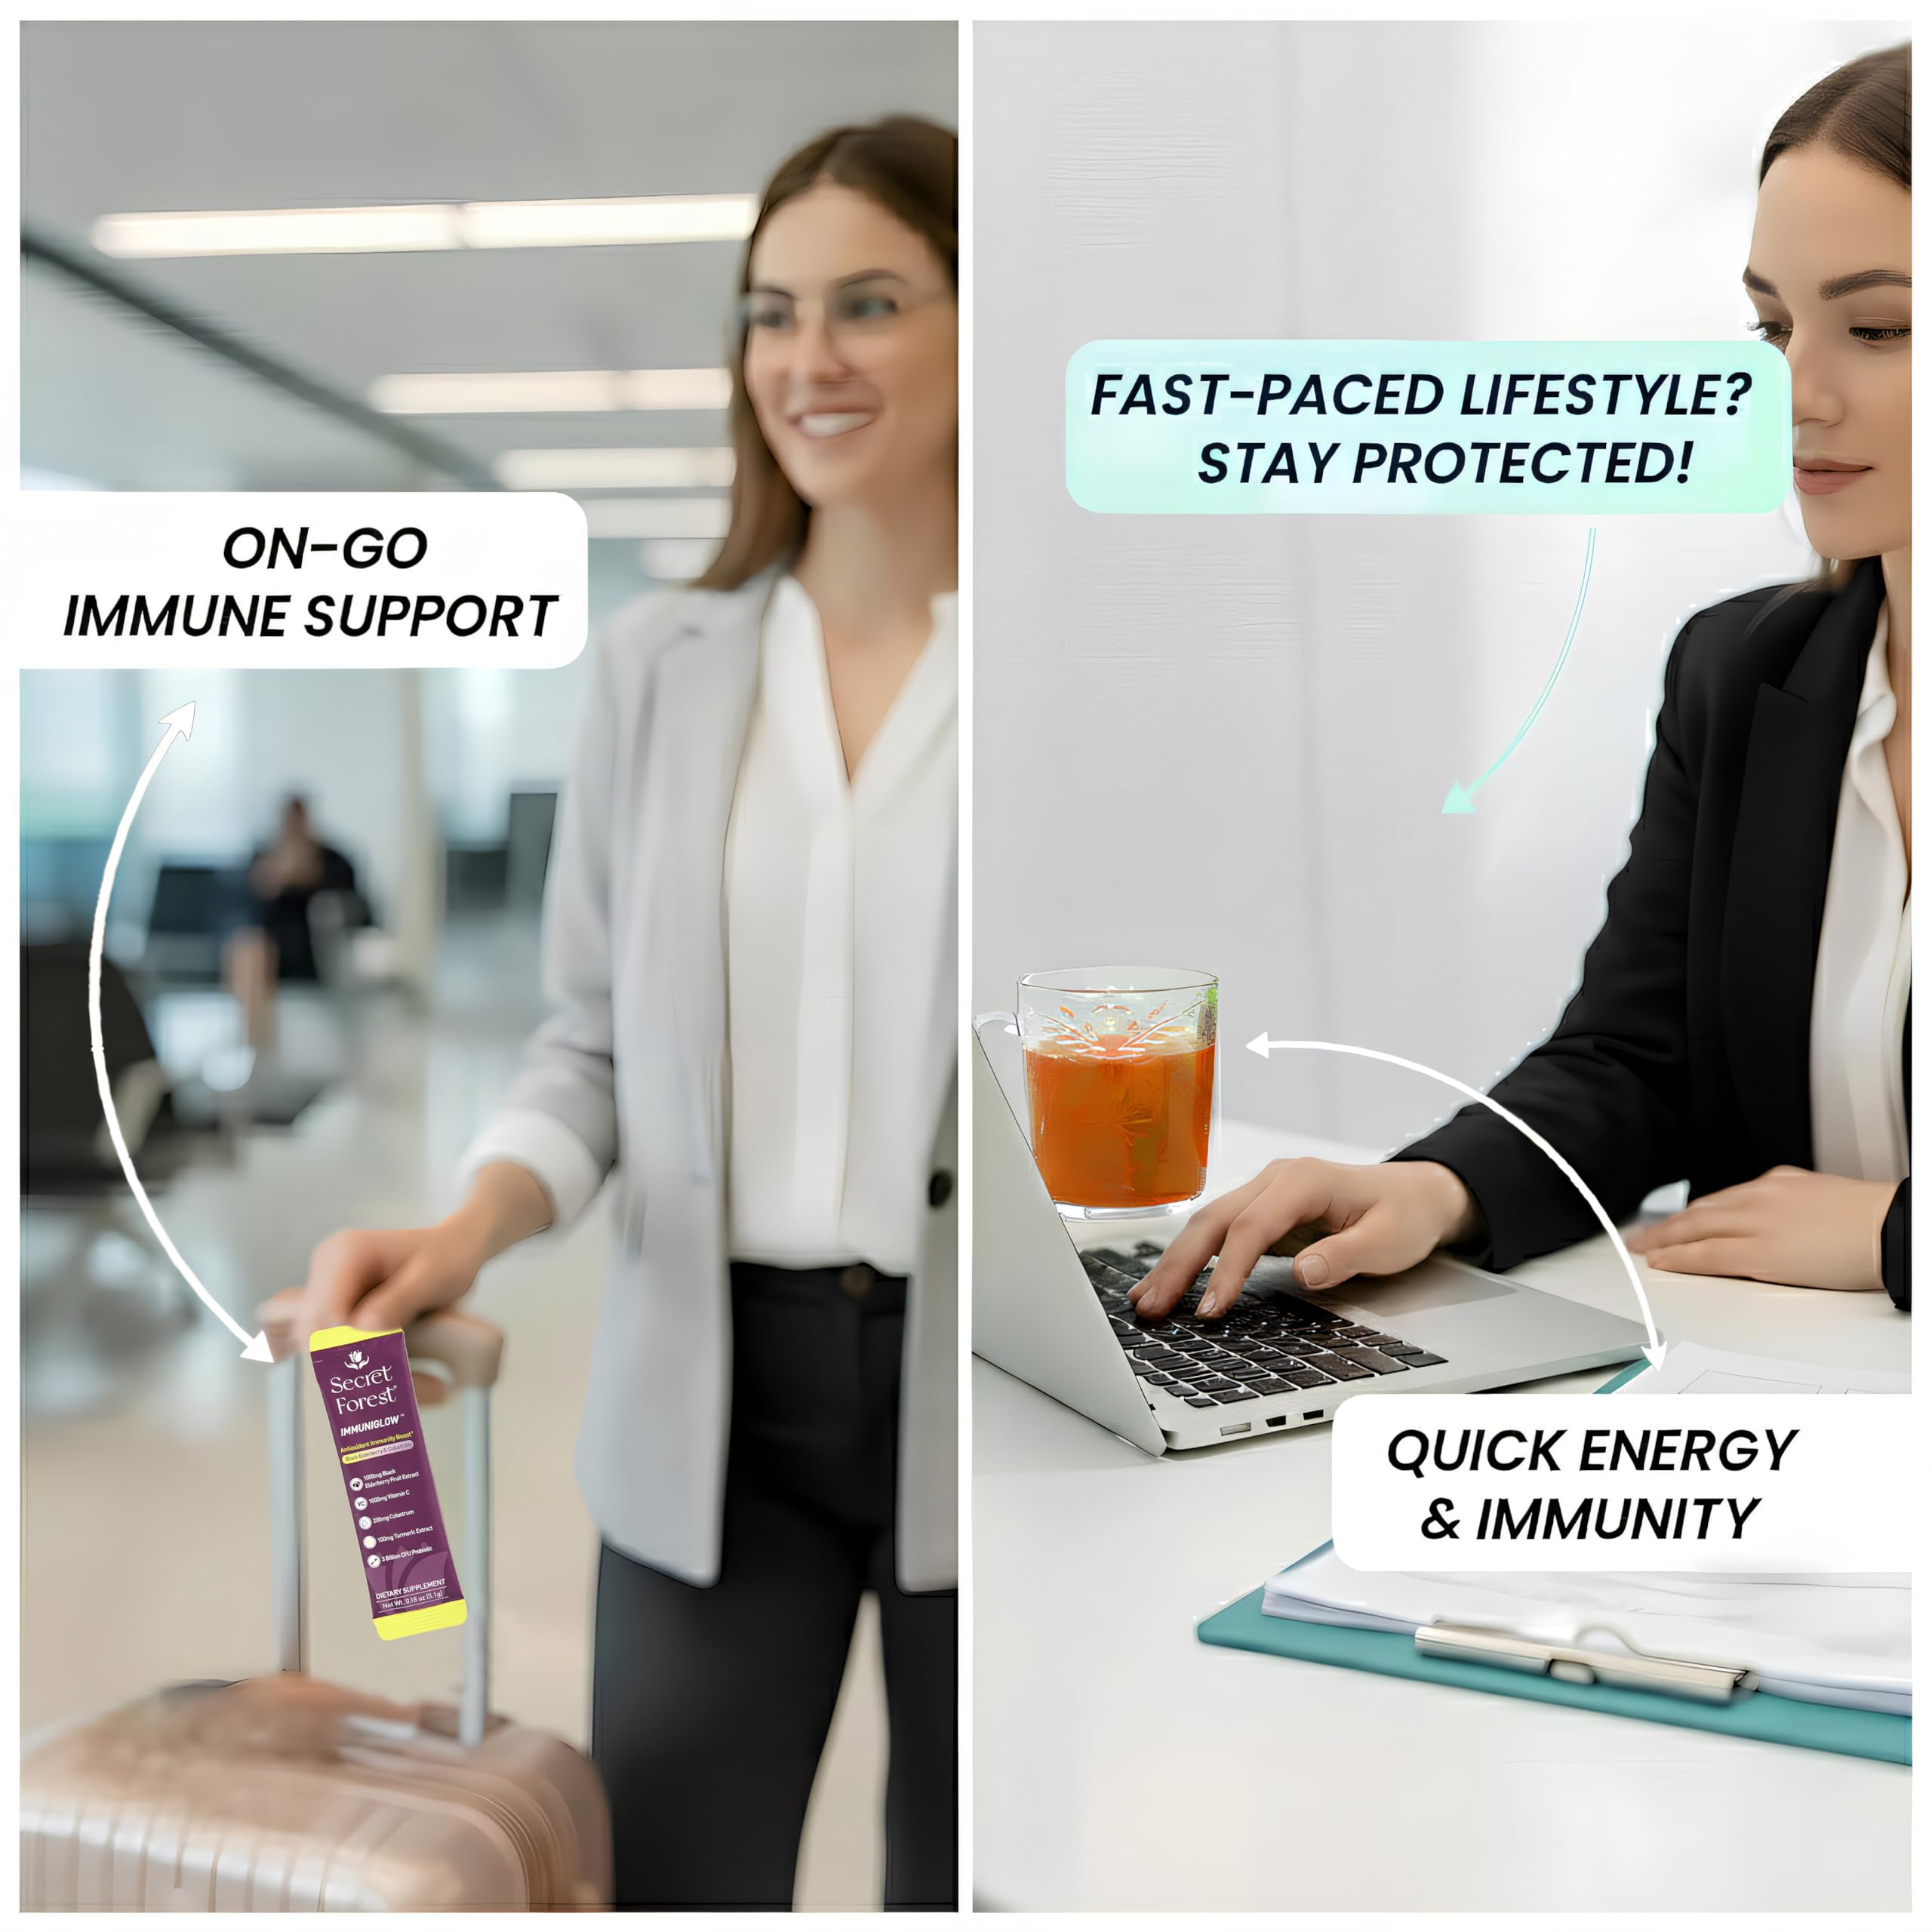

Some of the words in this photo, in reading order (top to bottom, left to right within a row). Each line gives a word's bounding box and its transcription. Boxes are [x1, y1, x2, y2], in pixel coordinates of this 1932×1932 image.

[331, 1365, 392, 1393] Secret
[340, 1441, 370, 1453] Antioxidant
[370, 1436, 395, 1447] Immunity
[363, 1472, 383, 1481] 1000mg
[382, 1469, 396, 1477] Black
[365, 1478, 390, 1489] Elderberry
[401, 1471, 420, 1480] Extract
[368, 1496, 388, 1504] 1000mg
[387, 1491, 406, 1500] Vitamin
[372, 1515, 389, 1524] 200mg
[393, 1529, 416, 1540] Turmeric
[416, 1525, 434, 1534] Extract
[411, 1546, 433, 1555] Probiotic
[375, 1589, 402, 1600] DIETARY
[402, 1578, 446, 1594] SUPPLEMENT
[405, 1596, 417, 1604] 0.18
[426, 1590, 444, 1600] (5.1g)
